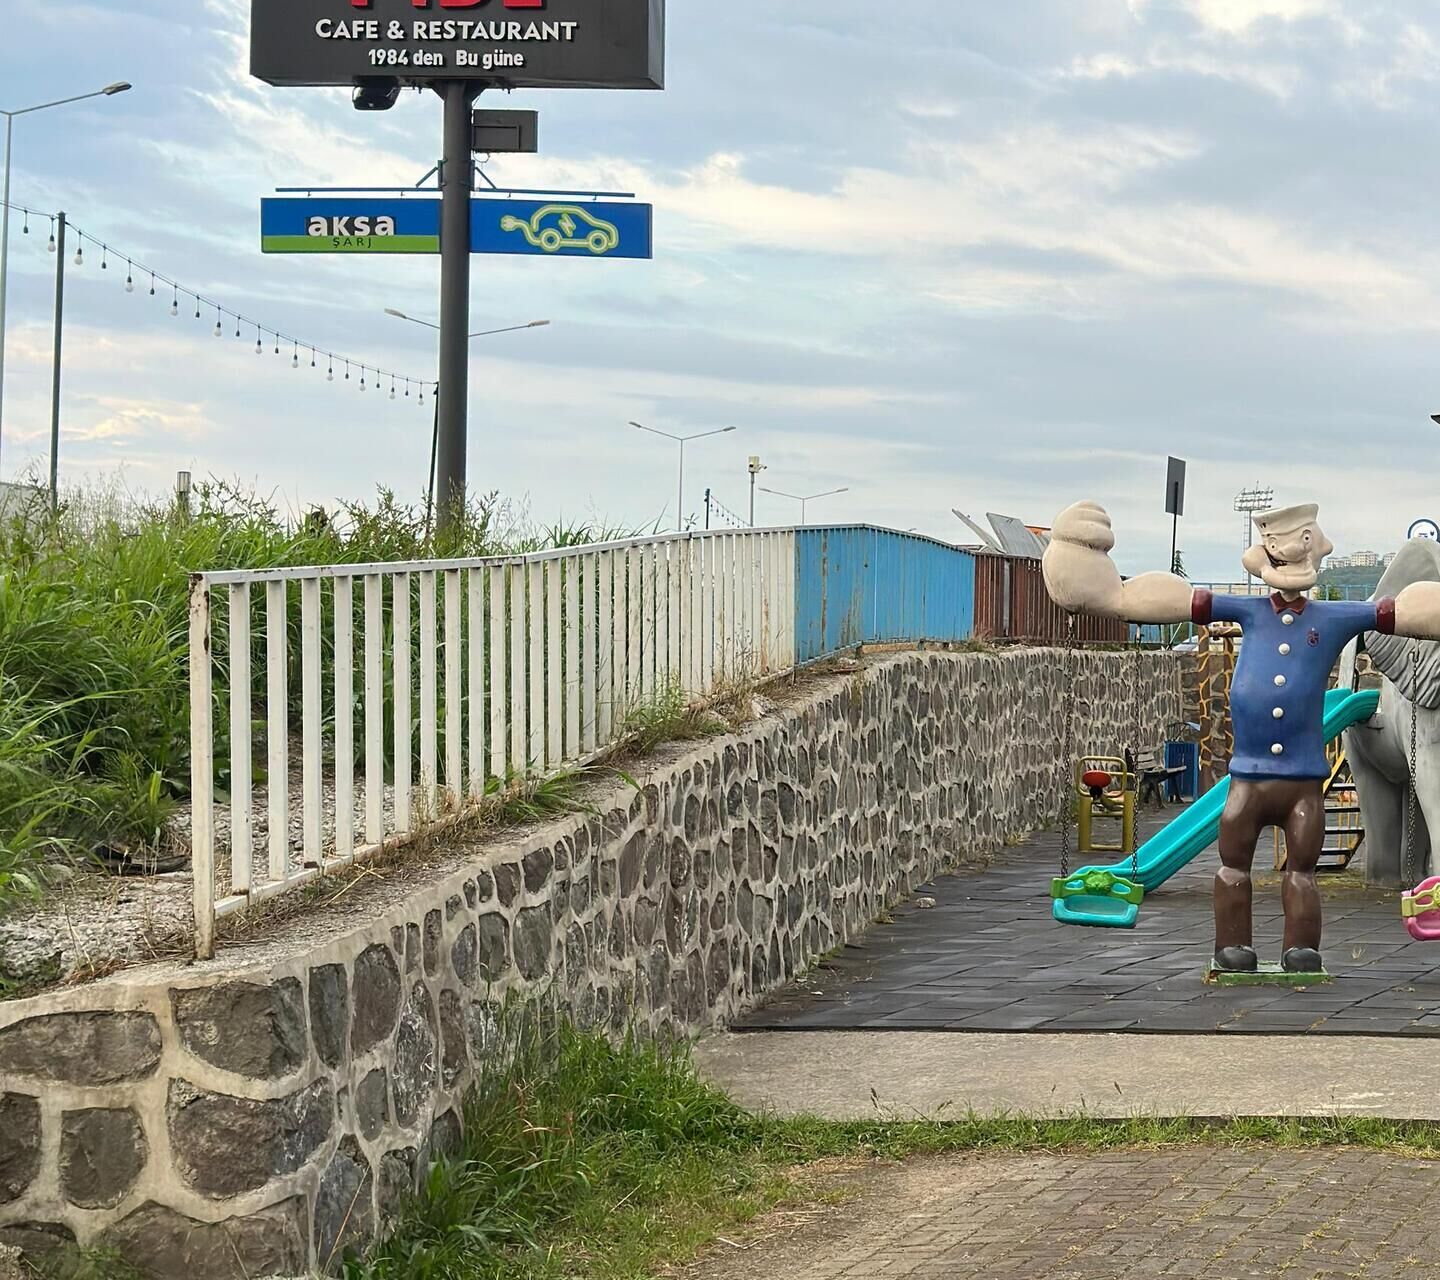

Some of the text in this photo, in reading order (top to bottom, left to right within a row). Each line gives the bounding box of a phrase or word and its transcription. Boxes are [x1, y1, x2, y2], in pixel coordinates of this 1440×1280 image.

[315, 18, 577, 41] CAFE & RESTAURANT
[368, 49, 525, 71] 1984 den Bu güne
[308, 215, 395, 237] aksa
[332, 237, 373, 249] ŞARJ
